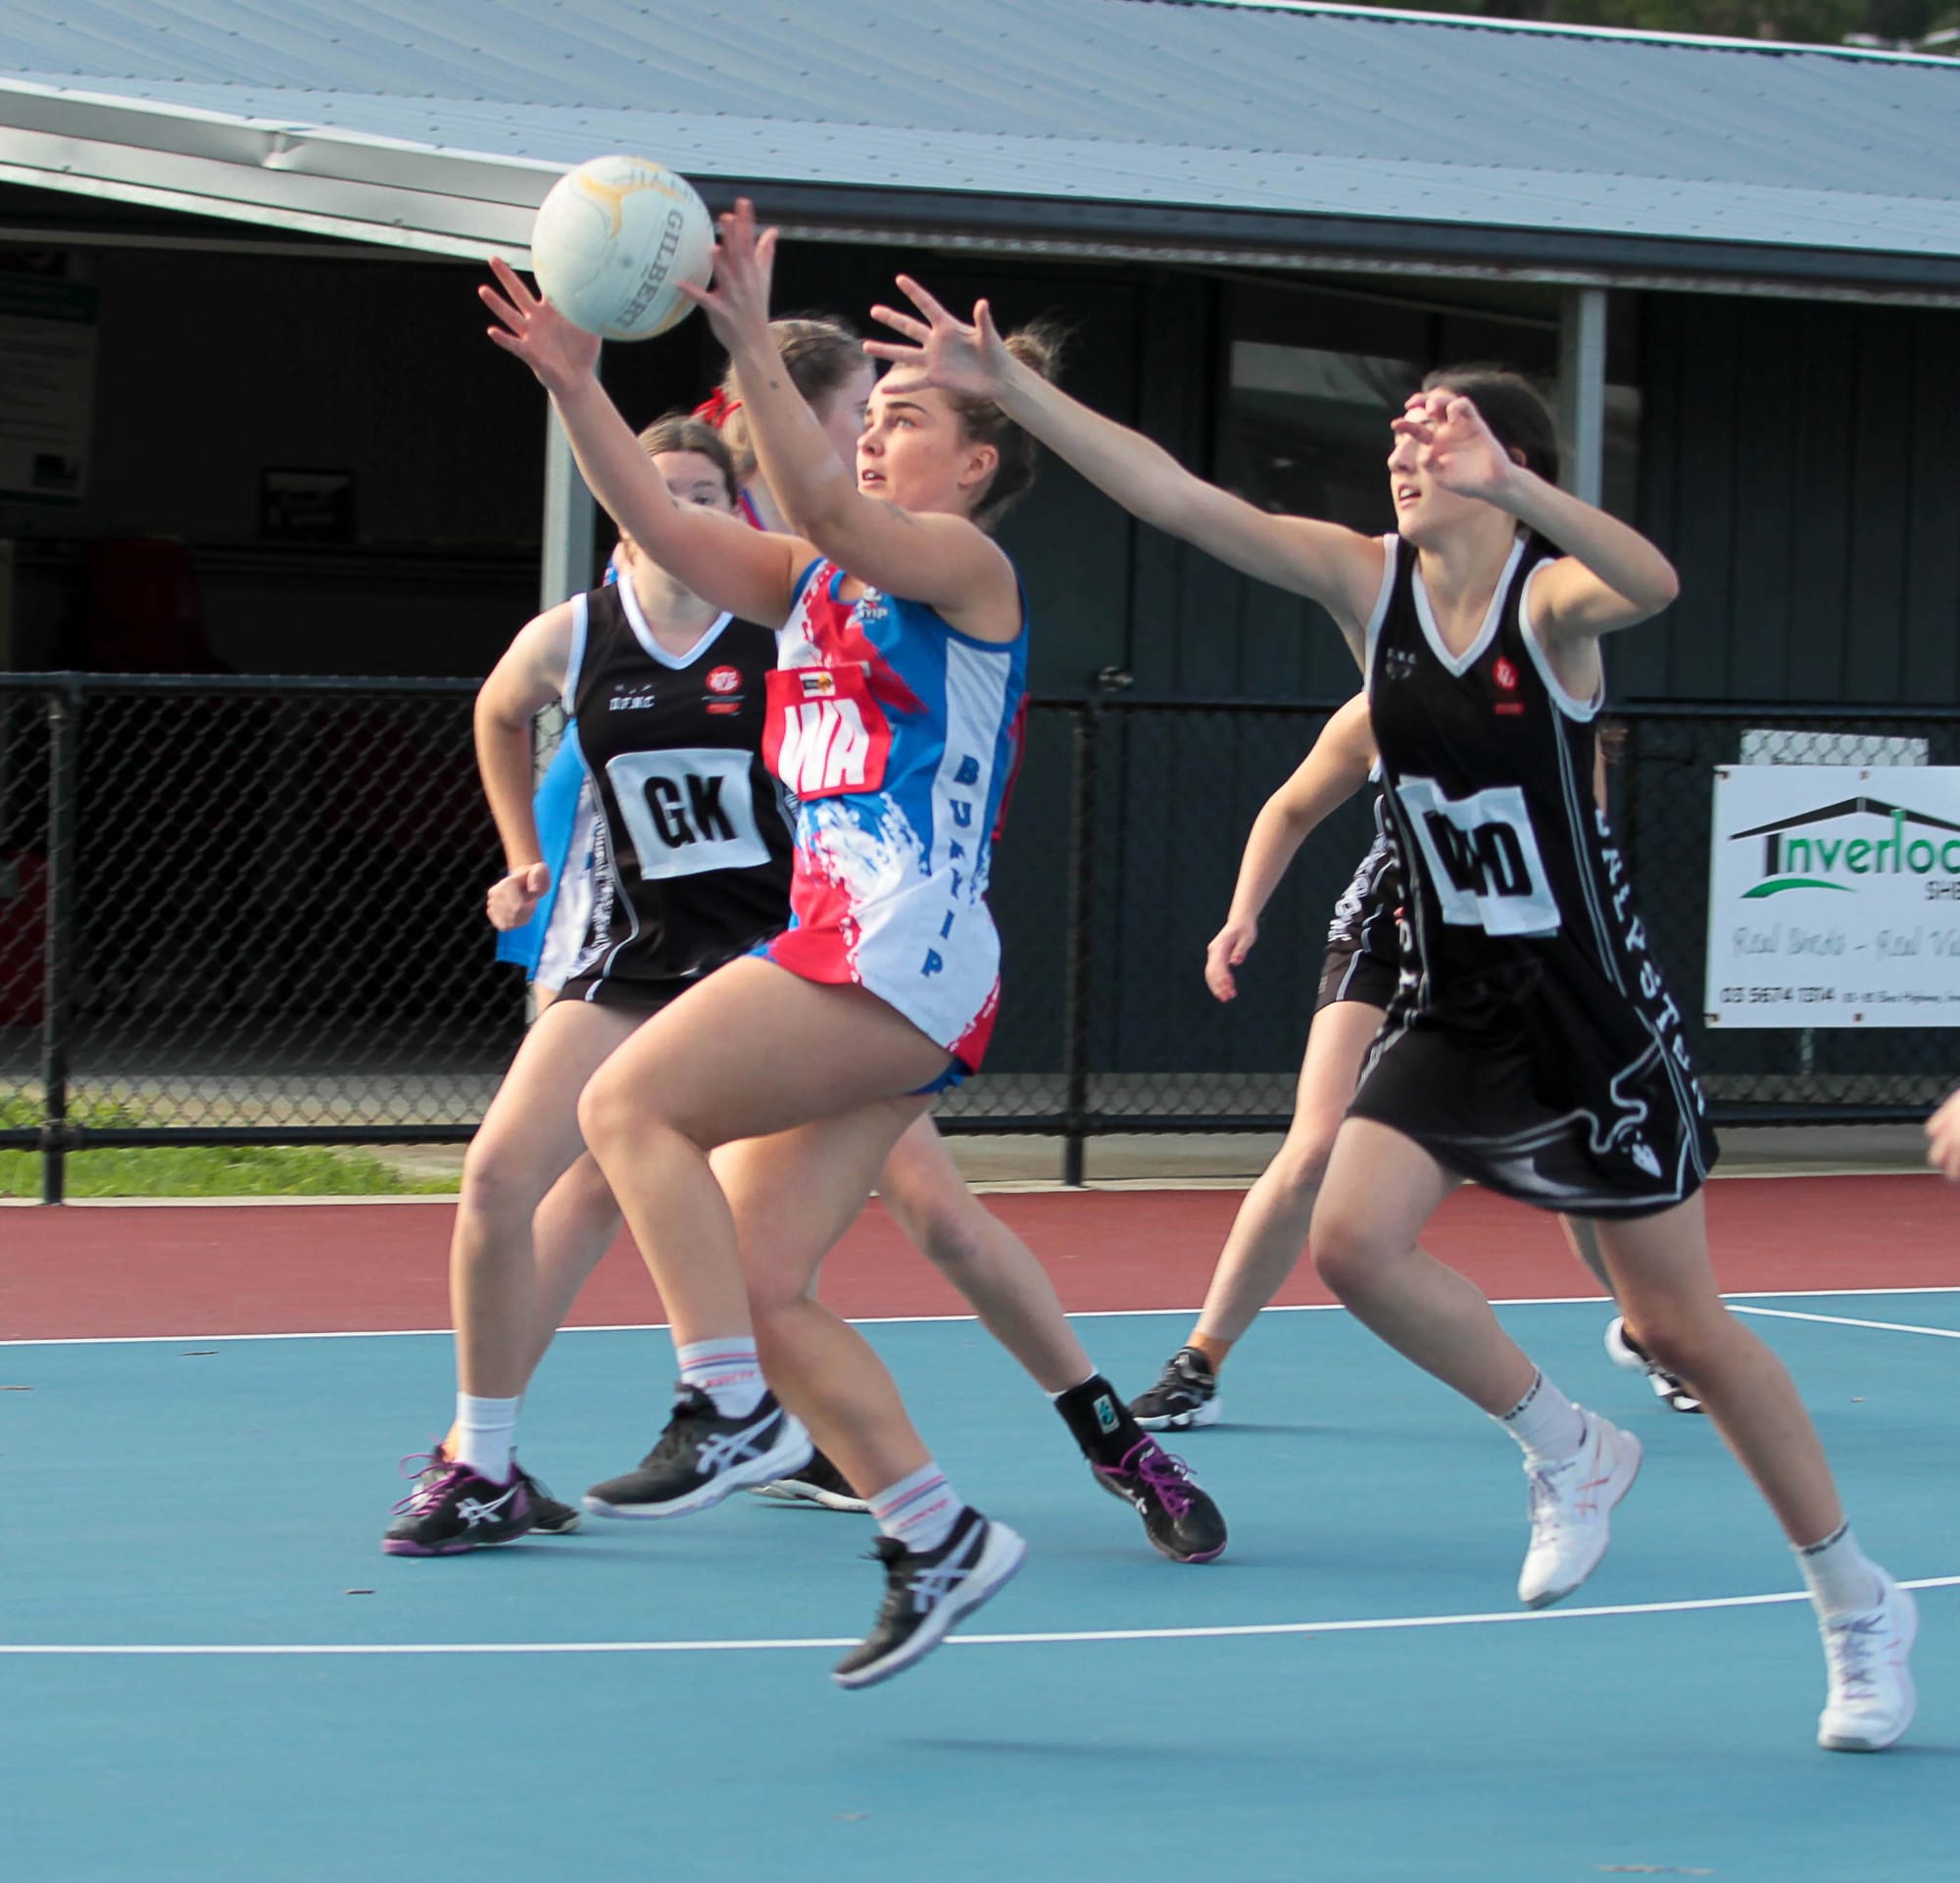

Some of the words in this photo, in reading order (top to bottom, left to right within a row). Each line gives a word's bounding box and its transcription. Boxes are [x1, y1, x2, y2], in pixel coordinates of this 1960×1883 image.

[616, 209, 684, 327] GILBERT
[778, 699, 870, 793] WA
[643, 773, 739, 849] GK
